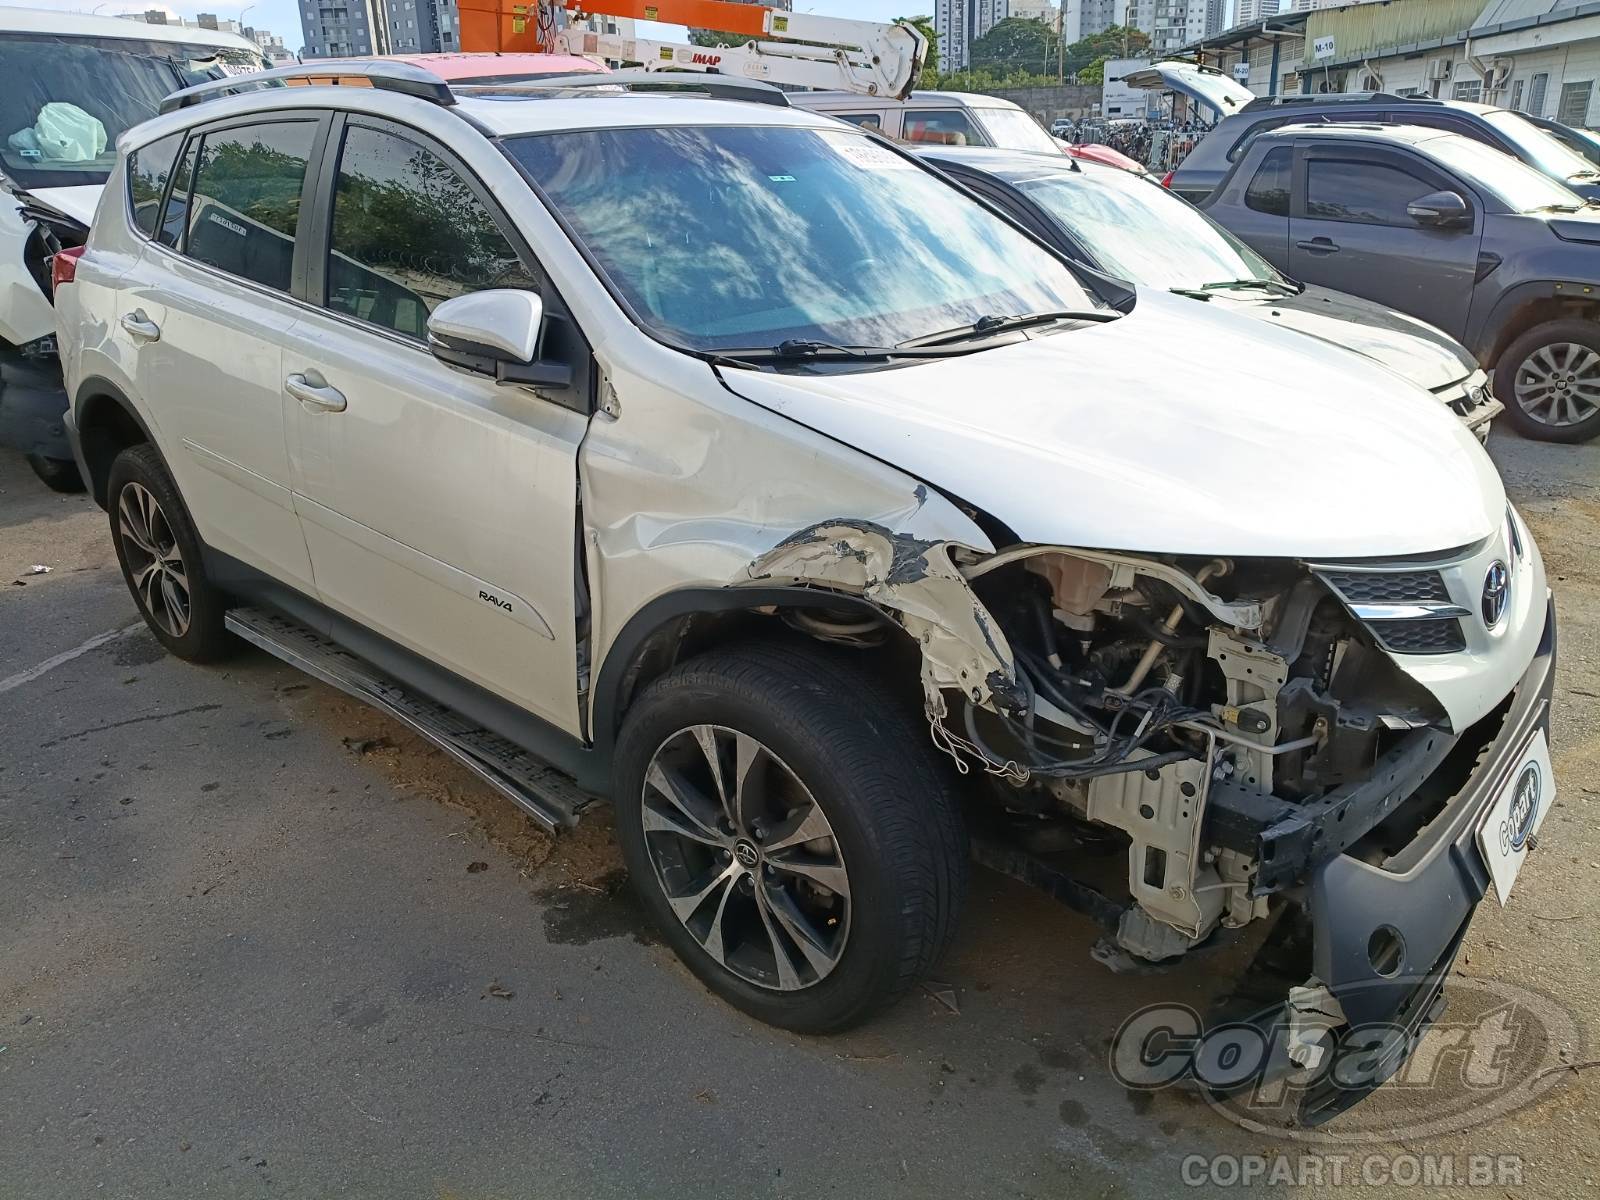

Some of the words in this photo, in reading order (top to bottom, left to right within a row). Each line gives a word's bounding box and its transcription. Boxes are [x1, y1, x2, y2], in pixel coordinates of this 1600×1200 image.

[1315, 41, 1334, 53] M-10
[692, 53, 721, 66] IMAP
[1234, 67, 1249, 75] M-20
[479, 590, 512, 612] RAV4
[1500, 768, 1537, 857] Copart
